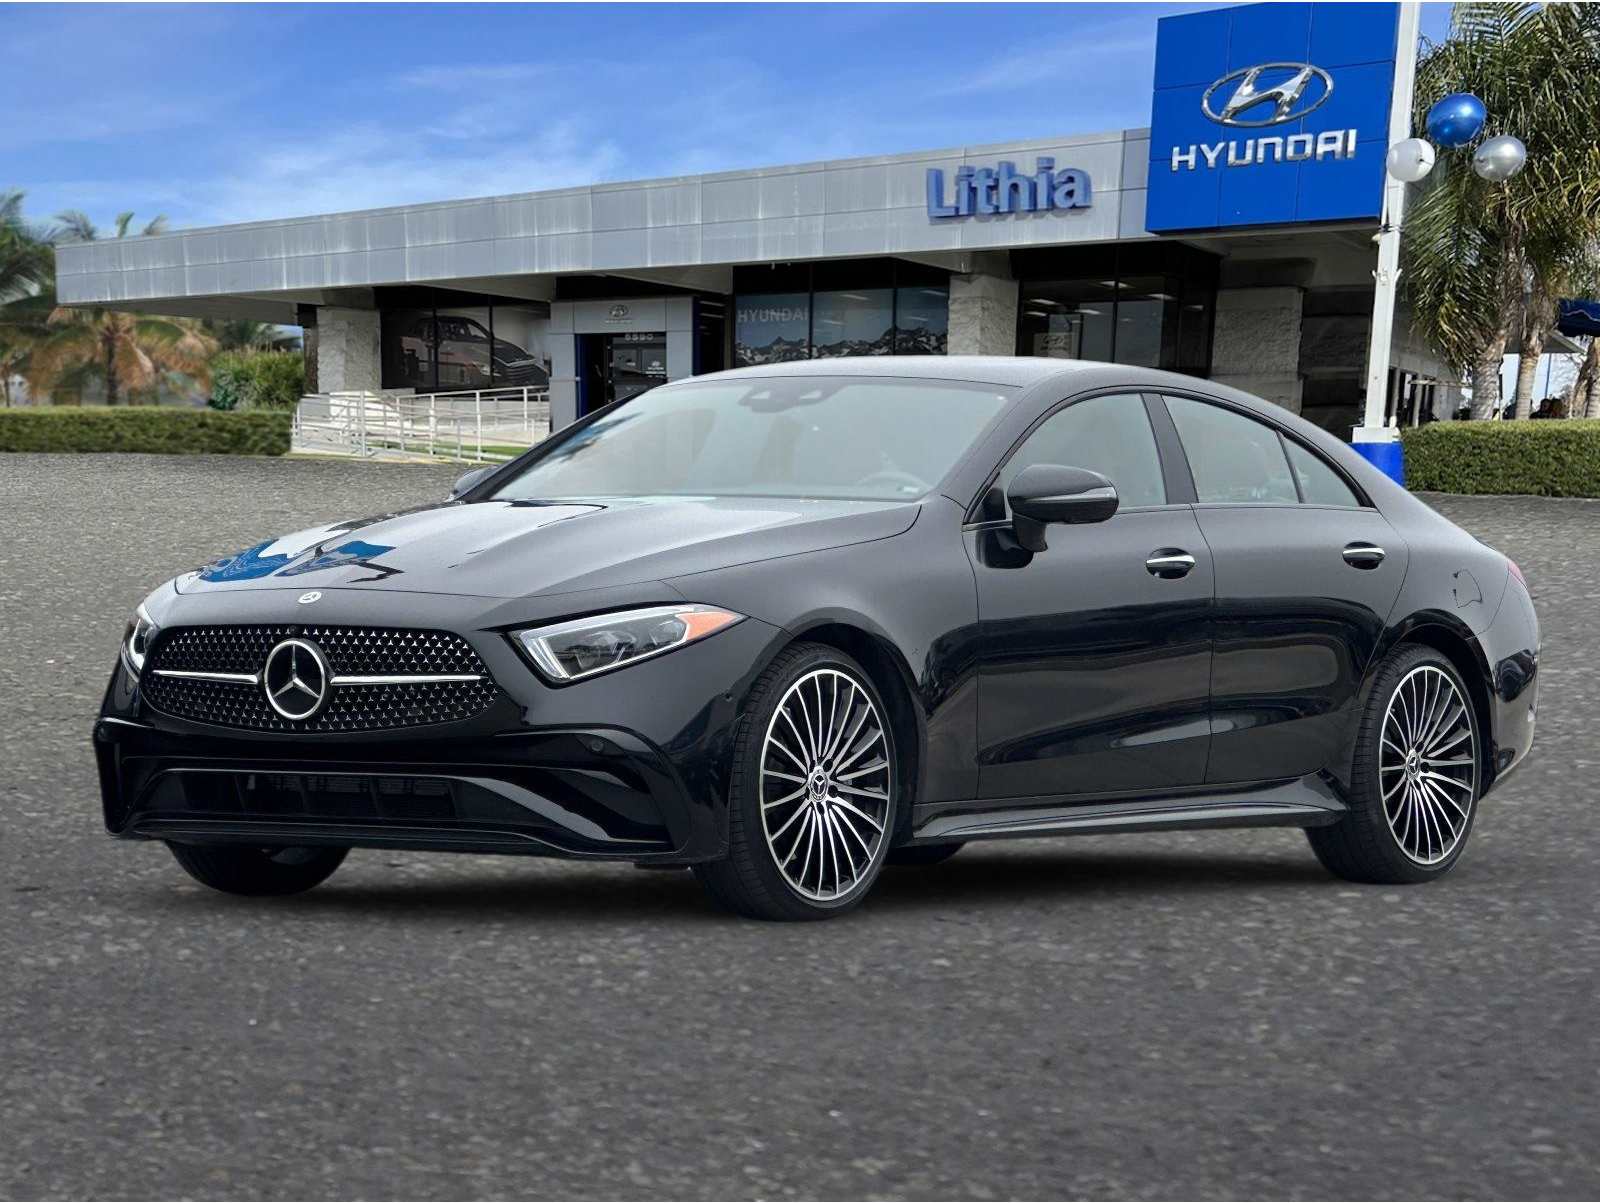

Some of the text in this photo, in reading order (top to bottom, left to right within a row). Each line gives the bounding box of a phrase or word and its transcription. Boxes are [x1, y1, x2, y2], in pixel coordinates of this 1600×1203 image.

[1171, 129, 1357, 172] HYUNDAI
[926, 156, 1092, 217] Lithia
[737, 307, 809, 323] HYUNDAI
